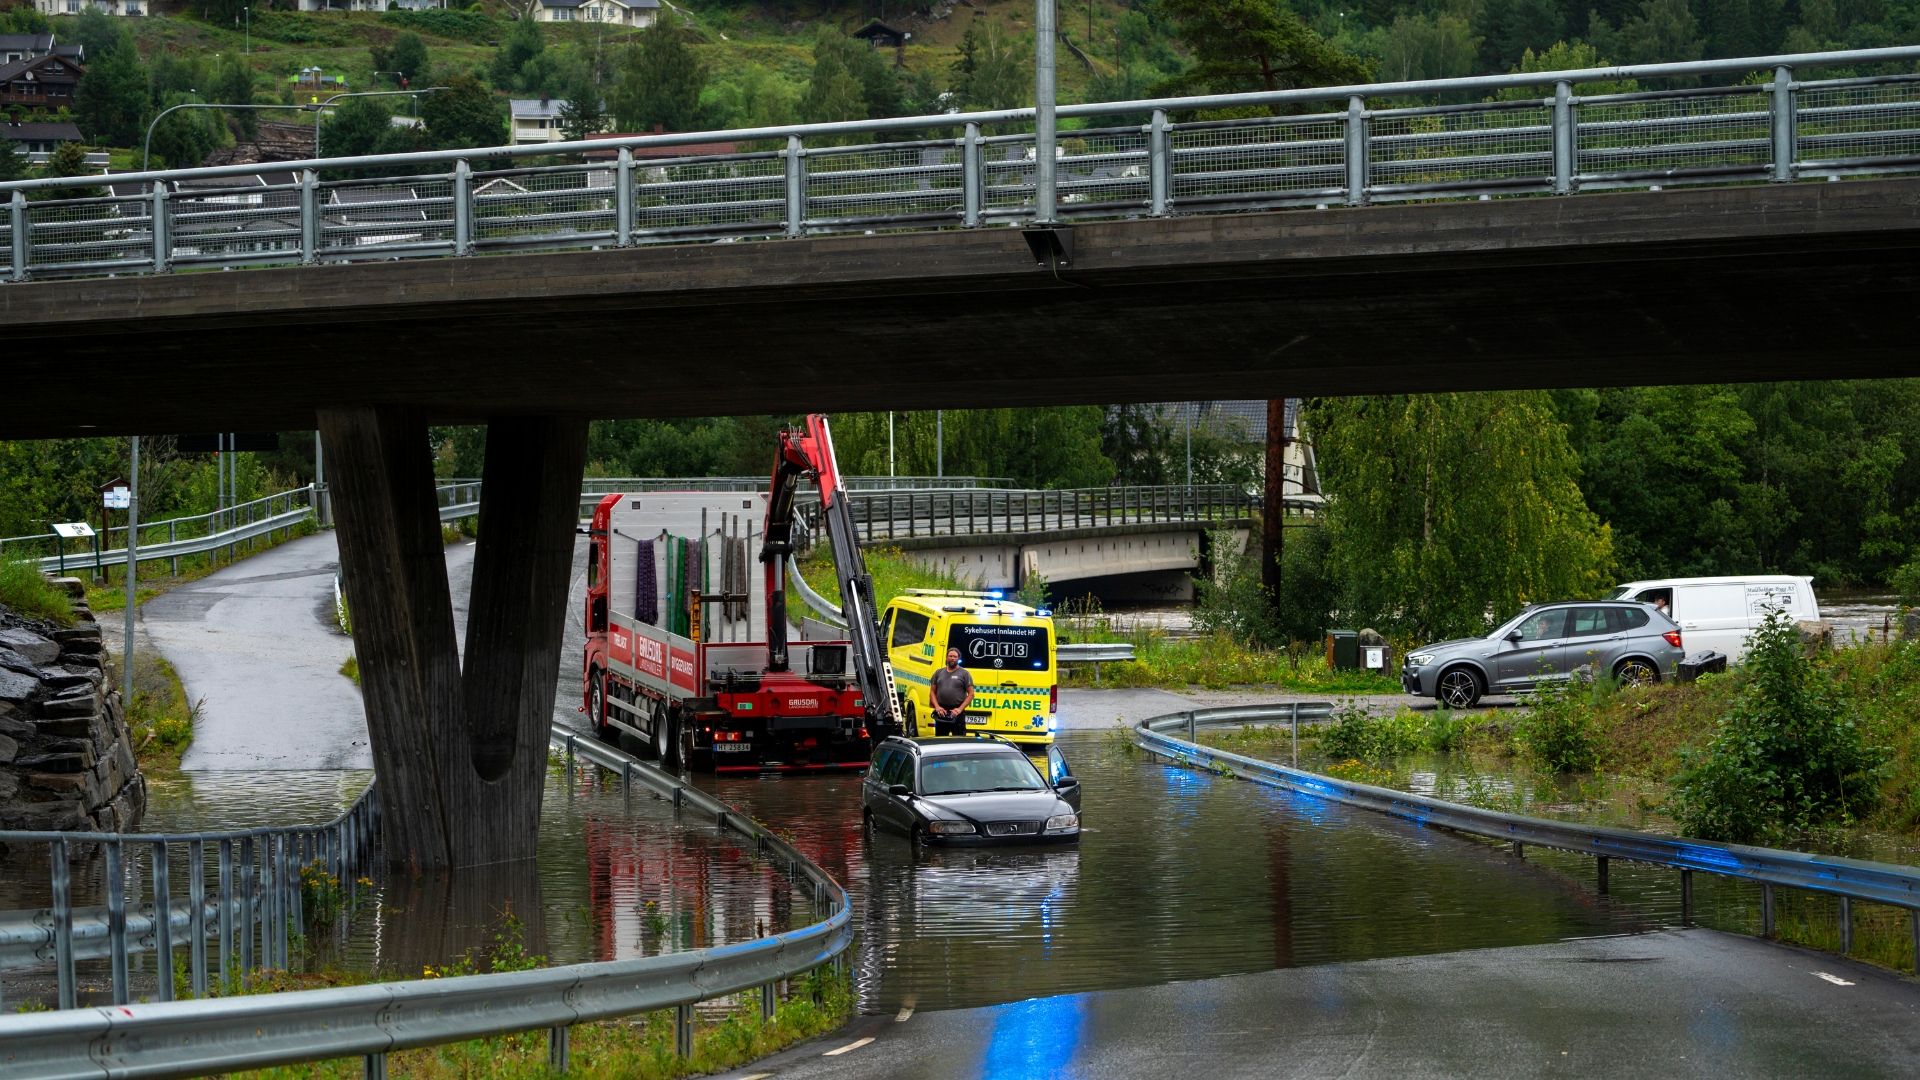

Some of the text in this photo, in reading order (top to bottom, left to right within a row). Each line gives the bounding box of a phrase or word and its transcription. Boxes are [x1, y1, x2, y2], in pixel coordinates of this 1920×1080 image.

[964, 626, 996, 634] Sykehuset
[998, 628, 1027, 636] Innlandet
[639, 636, 662, 664] GAUSDAL
[969, 698, 1041, 710] BULANSE
